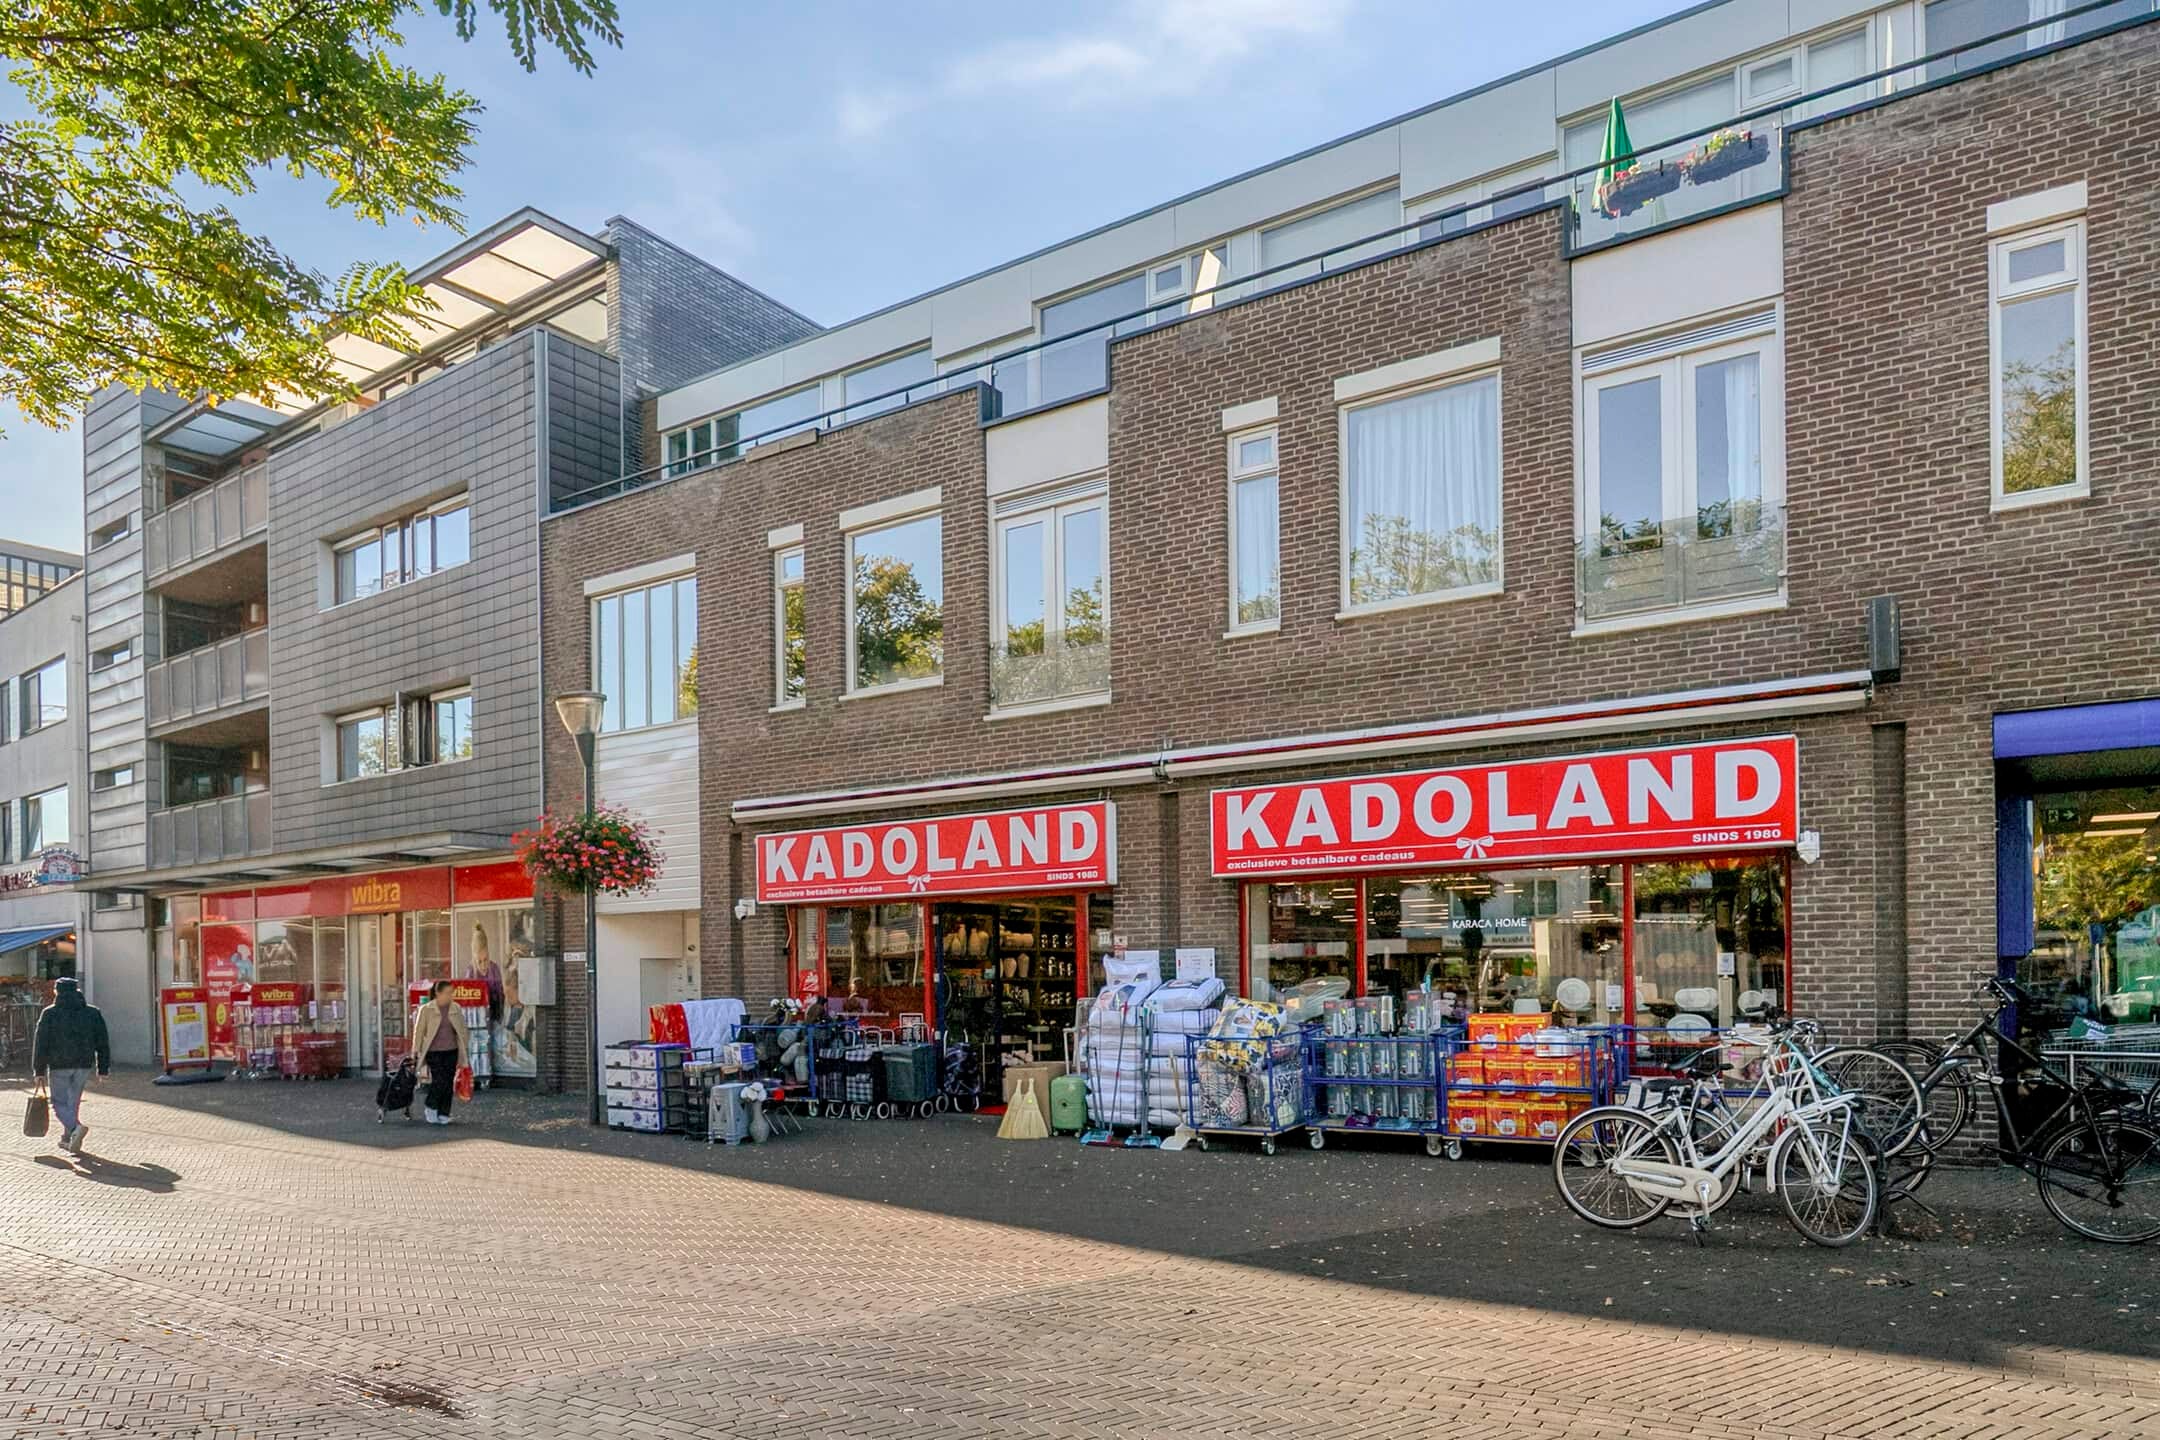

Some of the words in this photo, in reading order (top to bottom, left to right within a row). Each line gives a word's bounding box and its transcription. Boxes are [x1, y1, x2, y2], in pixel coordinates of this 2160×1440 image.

[1226, 749, 1782, 850] KADOLAND
[1692, 831, 1739, 843] SINDS
[1744, 829, 1781, 840] 1980
[766, 811, 1098, 883] KADOLAND
[1227, 857, 1288, 870] exclusieve
[1291, 854, 1357, 866] betaalbare
[1360, 851, 1415, 862] cadeaus
[1047, 871, 1074, 881] SINDS
[1077, 870, 1098, 879] 1980
[352, 877, 400, 905] wibra
[766, 889, 804, 898] exclusieve
[806, 887, 847, 896] betaalbare
[848, 885, 882, 894] cadeaus
[1452, 919, 1492, 929] KARACA
[1495, 917, 1527, 928] HOME
[261, 989, 294, 1000] wibra
